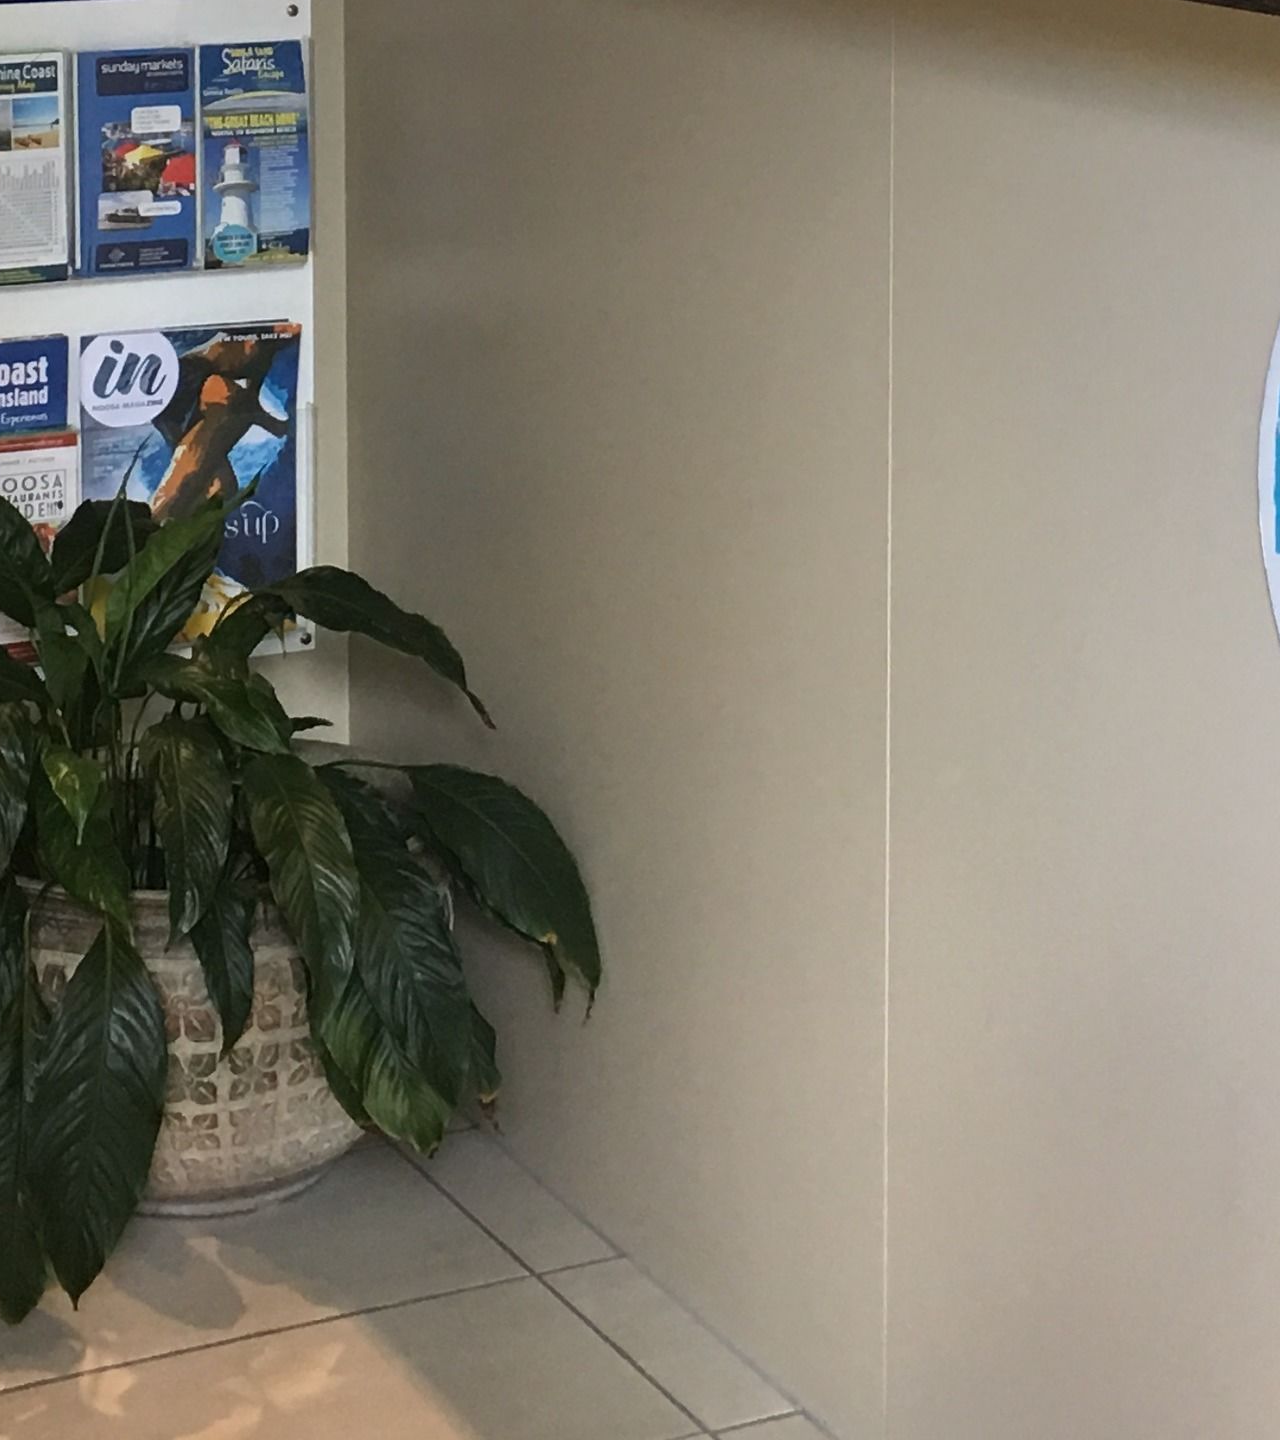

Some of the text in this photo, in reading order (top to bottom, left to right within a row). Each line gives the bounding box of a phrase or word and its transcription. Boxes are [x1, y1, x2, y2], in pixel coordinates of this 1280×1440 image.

[23, 64, 55, 79] Coast
[101, 60, 140, 75] sunday
[140, 58, 184, 71] markets
[221, 48, 277, 76] Safaris
[93, 340, 167, 399] in
[6, 489, 64, 503] TAURANTS
[224, 501, 280, 544] sup
